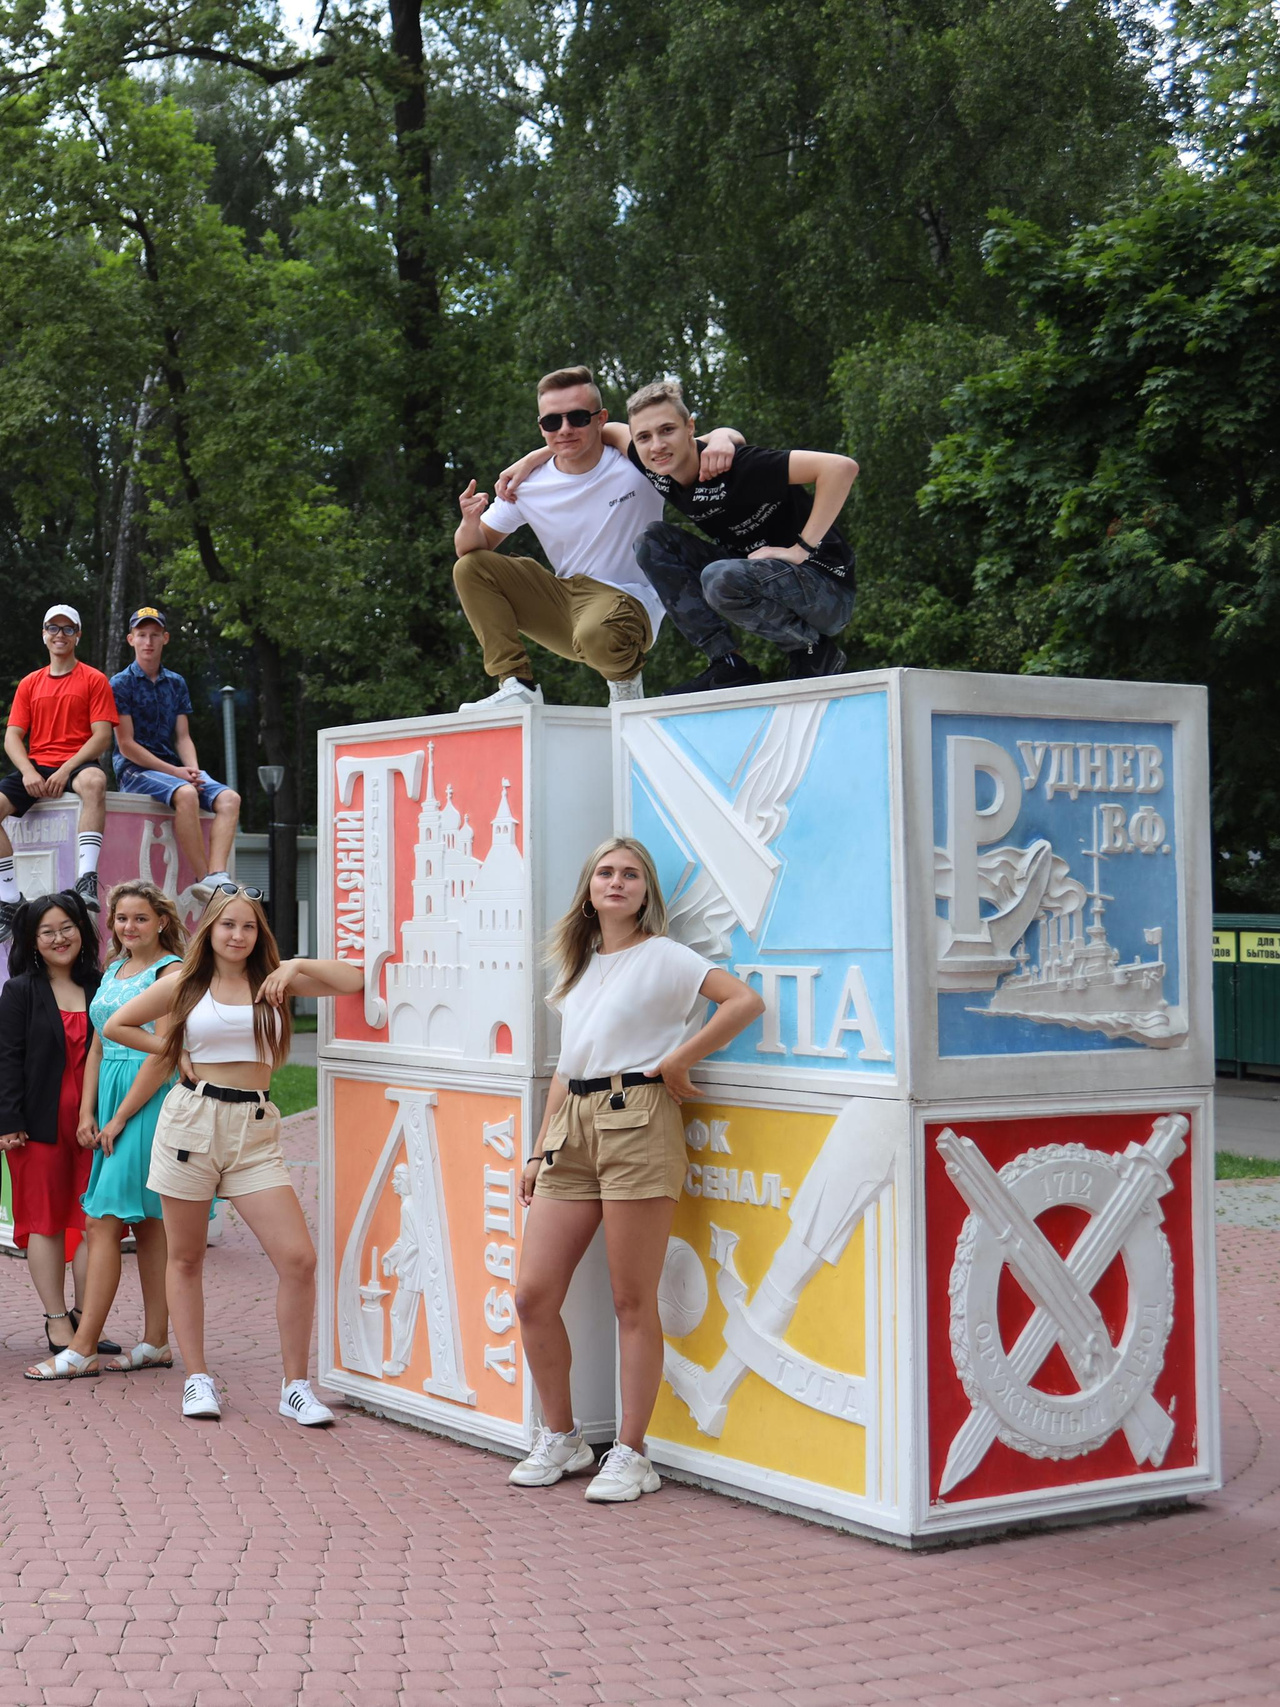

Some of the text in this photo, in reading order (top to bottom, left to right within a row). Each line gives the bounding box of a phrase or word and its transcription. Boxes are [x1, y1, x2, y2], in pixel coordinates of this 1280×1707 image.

[685, 1117, 732, 1155] ФК
[684, 1162, 790, 1209] СЕНАЛ-
[1040, 1169, 1093, 1202] 1712
[483, 1114, 516, 1384] ЛЕВША
[974, 1319, 1107, 1436] ОРУЖЕЙНЫЙ
